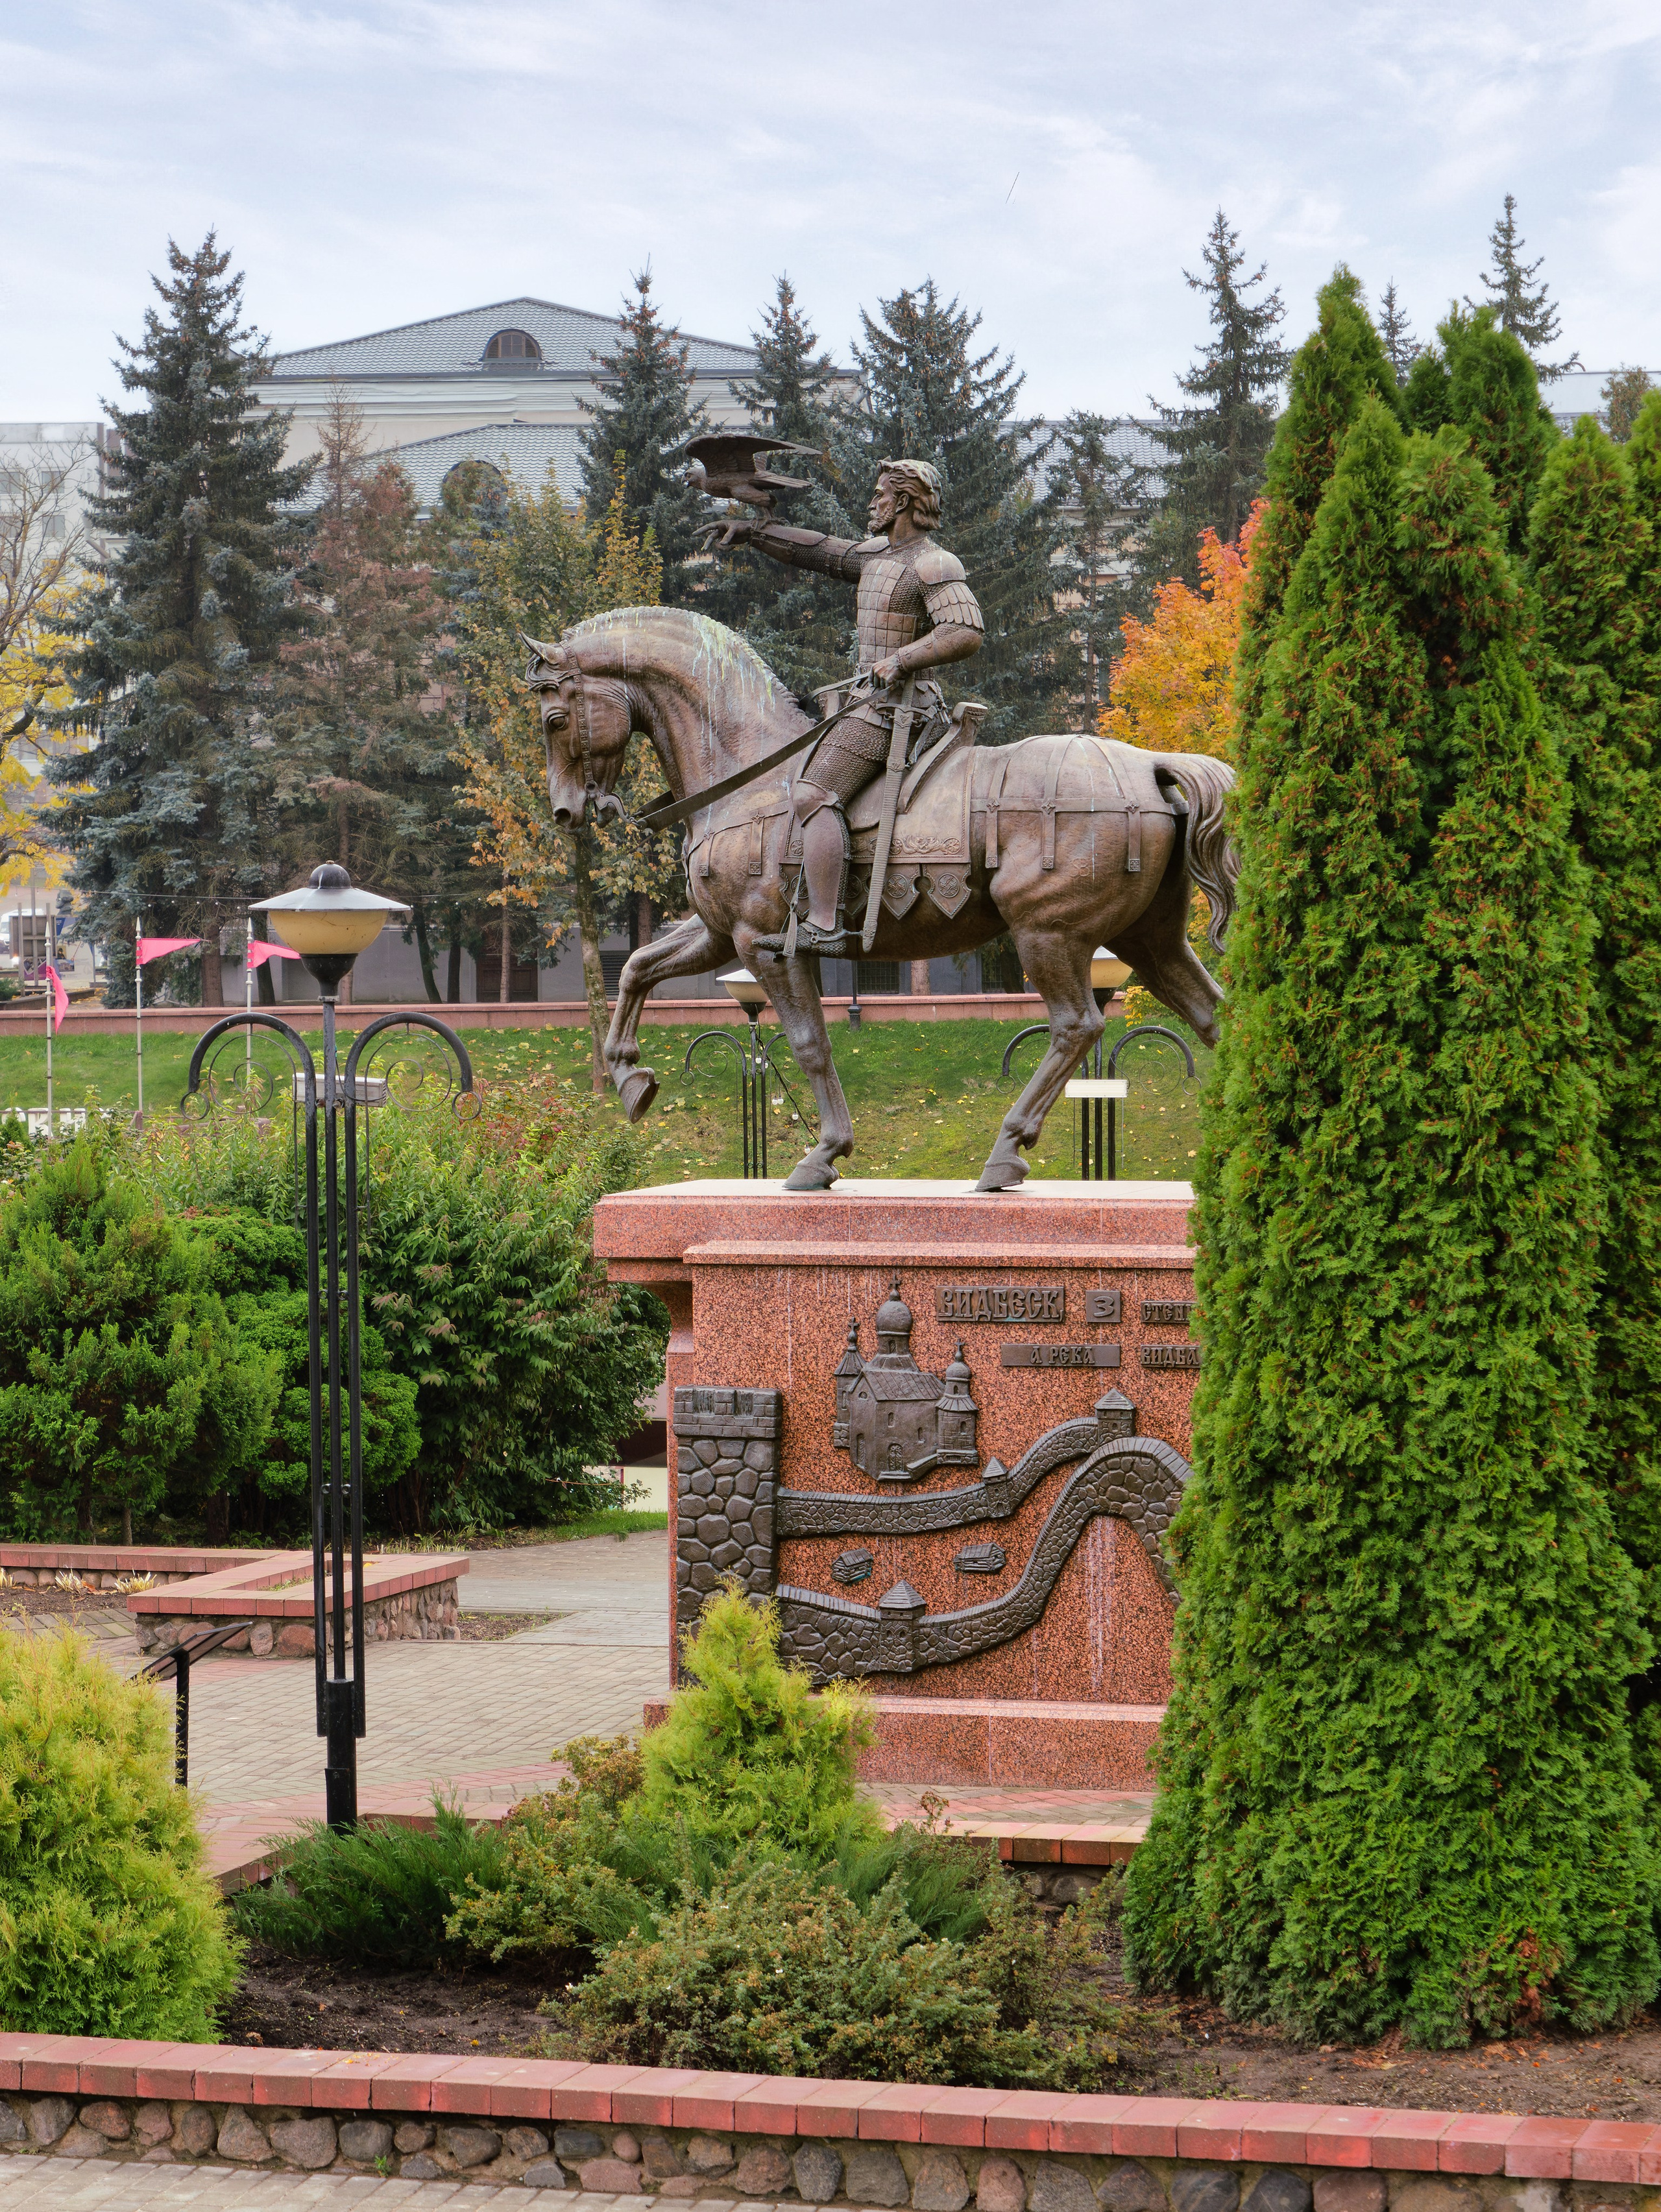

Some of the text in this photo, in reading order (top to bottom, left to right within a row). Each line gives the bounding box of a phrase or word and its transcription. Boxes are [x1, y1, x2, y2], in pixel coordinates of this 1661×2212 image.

[1030, 1345, 1200, 1367] А РЕКА ВИДБА
